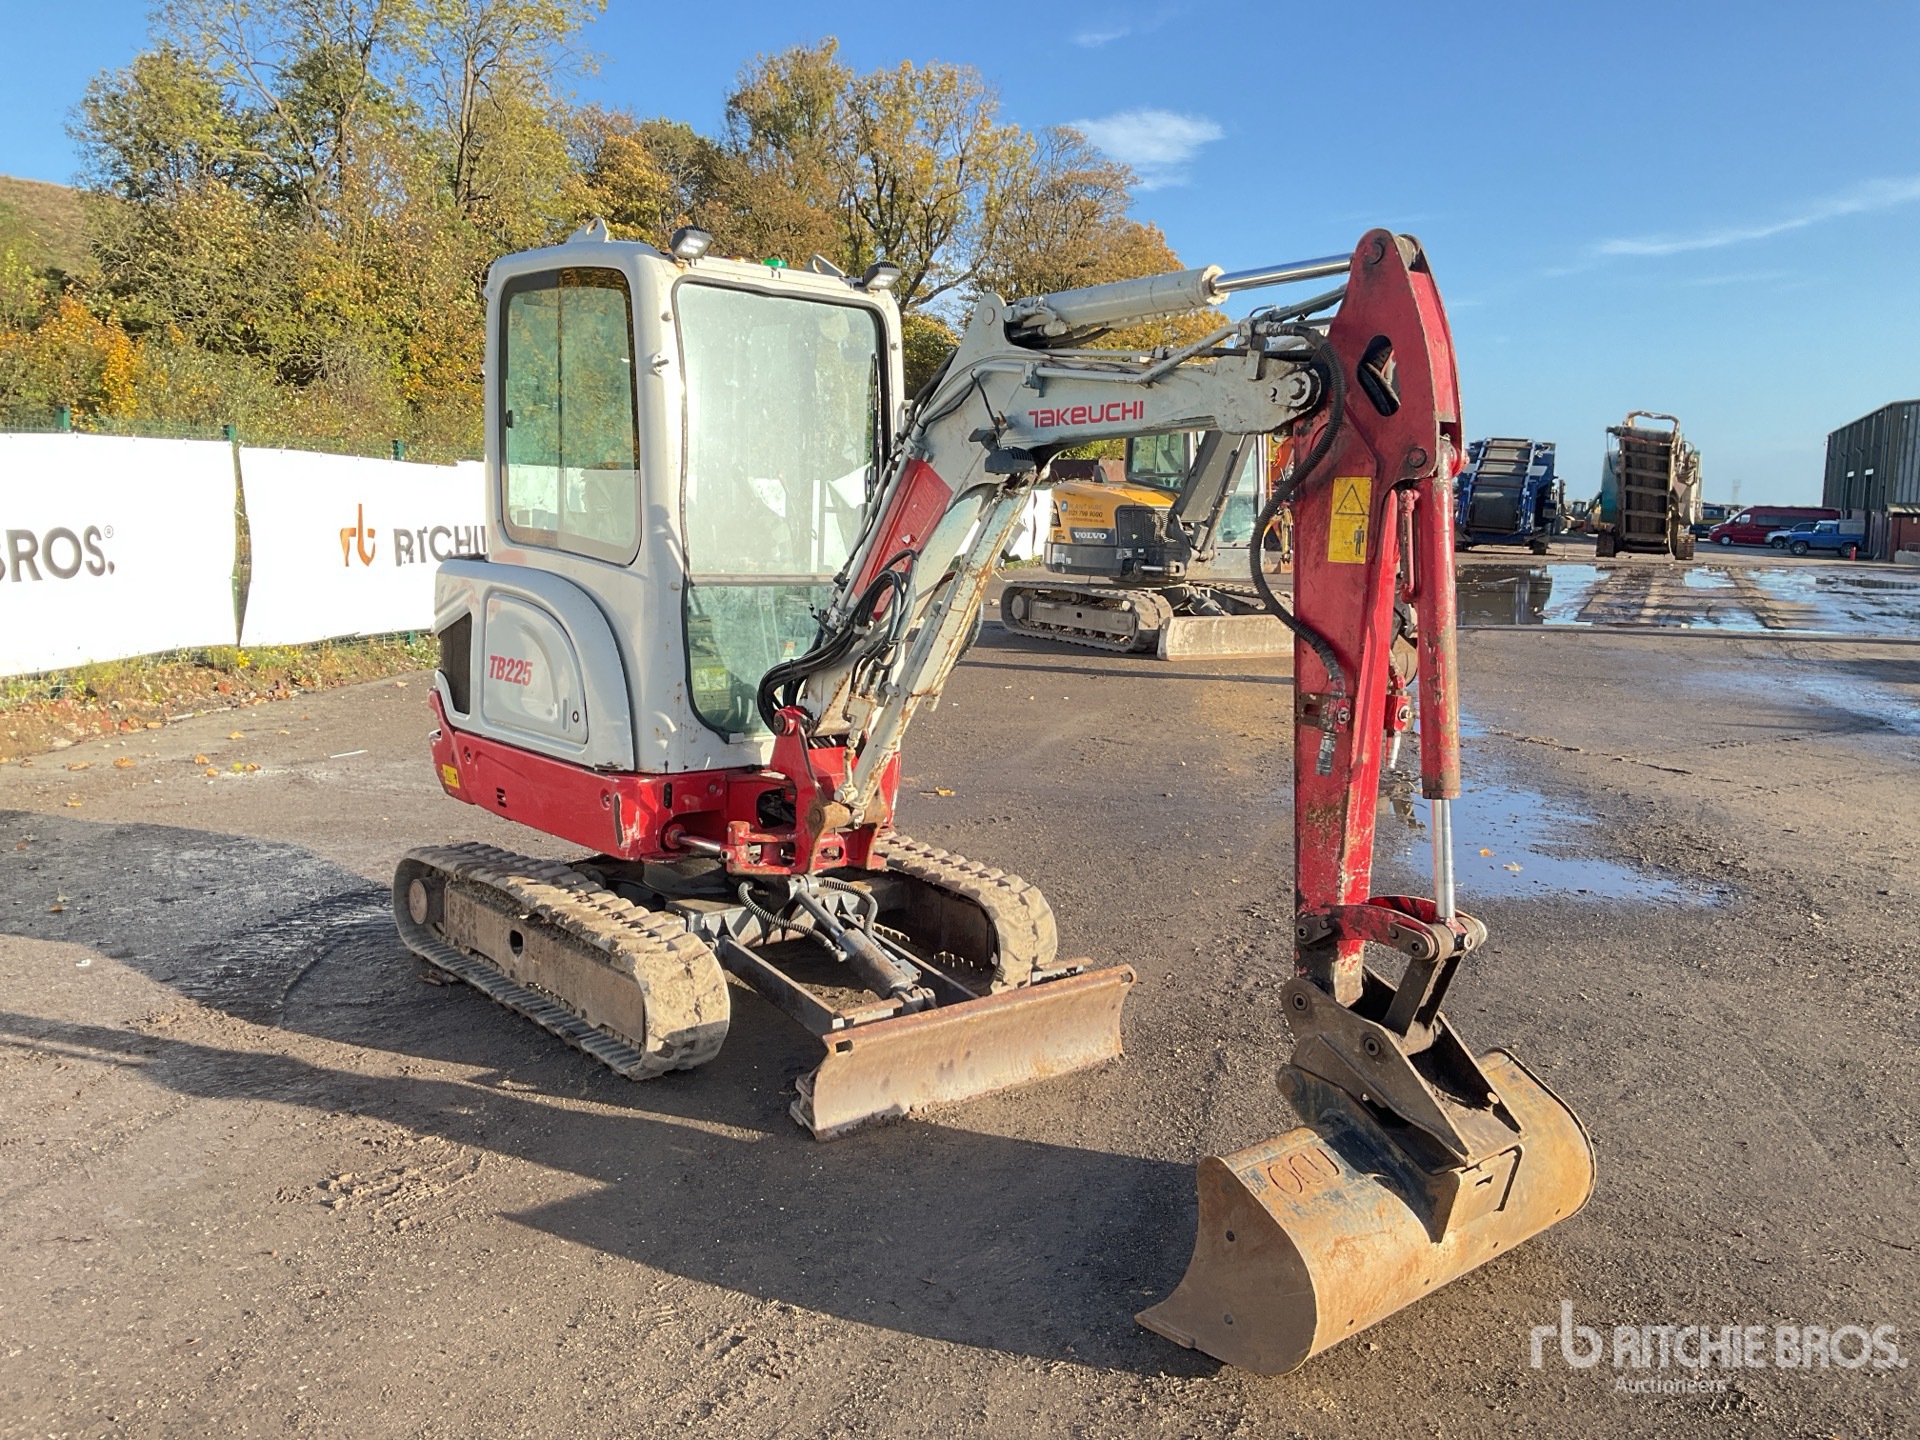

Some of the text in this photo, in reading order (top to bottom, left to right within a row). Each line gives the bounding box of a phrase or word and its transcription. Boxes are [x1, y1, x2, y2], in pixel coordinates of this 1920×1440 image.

[1028, 400, 1144, 428] TAKEUCHI
[1073, 531, 1107, 540] VOLVO
[0, 525, 115, 582] ROS.
[489, 654, 533, 687] TB225
